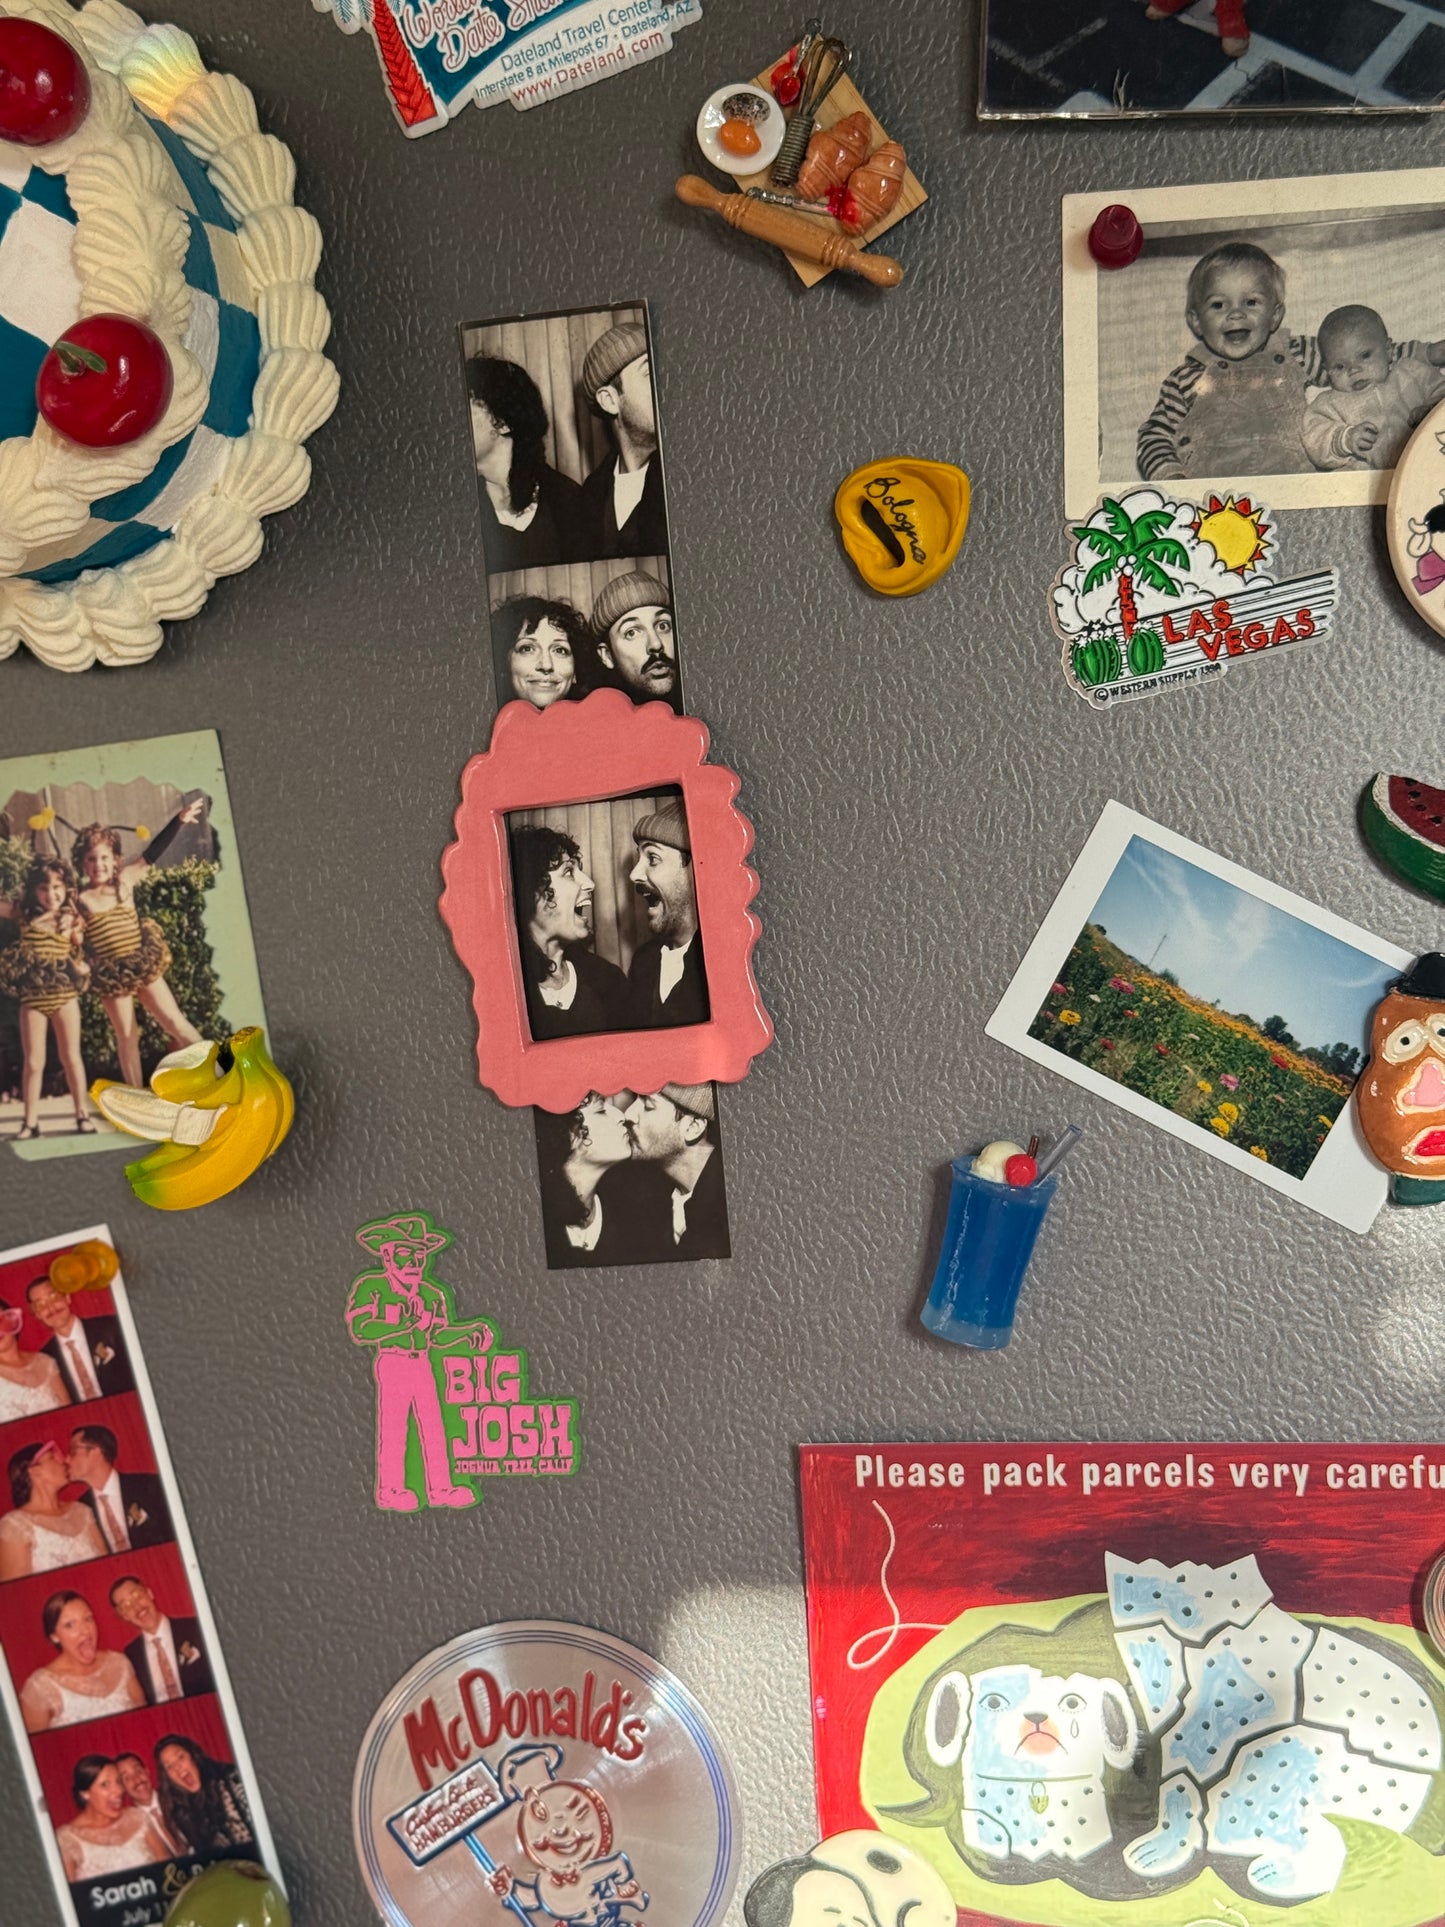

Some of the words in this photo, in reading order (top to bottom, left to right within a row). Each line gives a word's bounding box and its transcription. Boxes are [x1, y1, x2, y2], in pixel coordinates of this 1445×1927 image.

[441, 9, 502, 70] Date
[475, 71, 525, 98] Interstate
[525, 66, 534, 78] 8
[536, 61, 548, 75] at
[547, 41, 594, 69] Milepost
[595, 35, 609, 49] 67
[621, 7, 674, 38] Dateland,
[675, 0, 694, 15] AZ
[500, 32, 562, 72] Dateland
[562, 14, 606, 45] Travel
[607, 0, 653, 26] Center
[513, 32, 665, 101] www.Dateland.com
[1162, 600, 1233, 644] LAS
[1197, 608, 1315, 661] VEGAS
[1109, 680, 1158, 696] WESTERN
[1159, 668, 1197, 684] SUPPLY
[443, 1355, 521, 1404] BIG
[452, 1404, 574, 1459] JOSH
[454, 1460, 501, 1474] JOSHUA
[855, 1454, 965, 1488] Please
[983, 1453, 1067, 1495] pack
[1082, 1453, 1215, 1495] parcels
[1229, 1462, 1309, 1497] very
[1326, 1454, 1445, 1489] carefu
[403, 1668, 648, 1791] McDonald's
[408, 1786, 499, 1852] HAMBURGERS
[91, 1876, 157, 1908] Sarah
